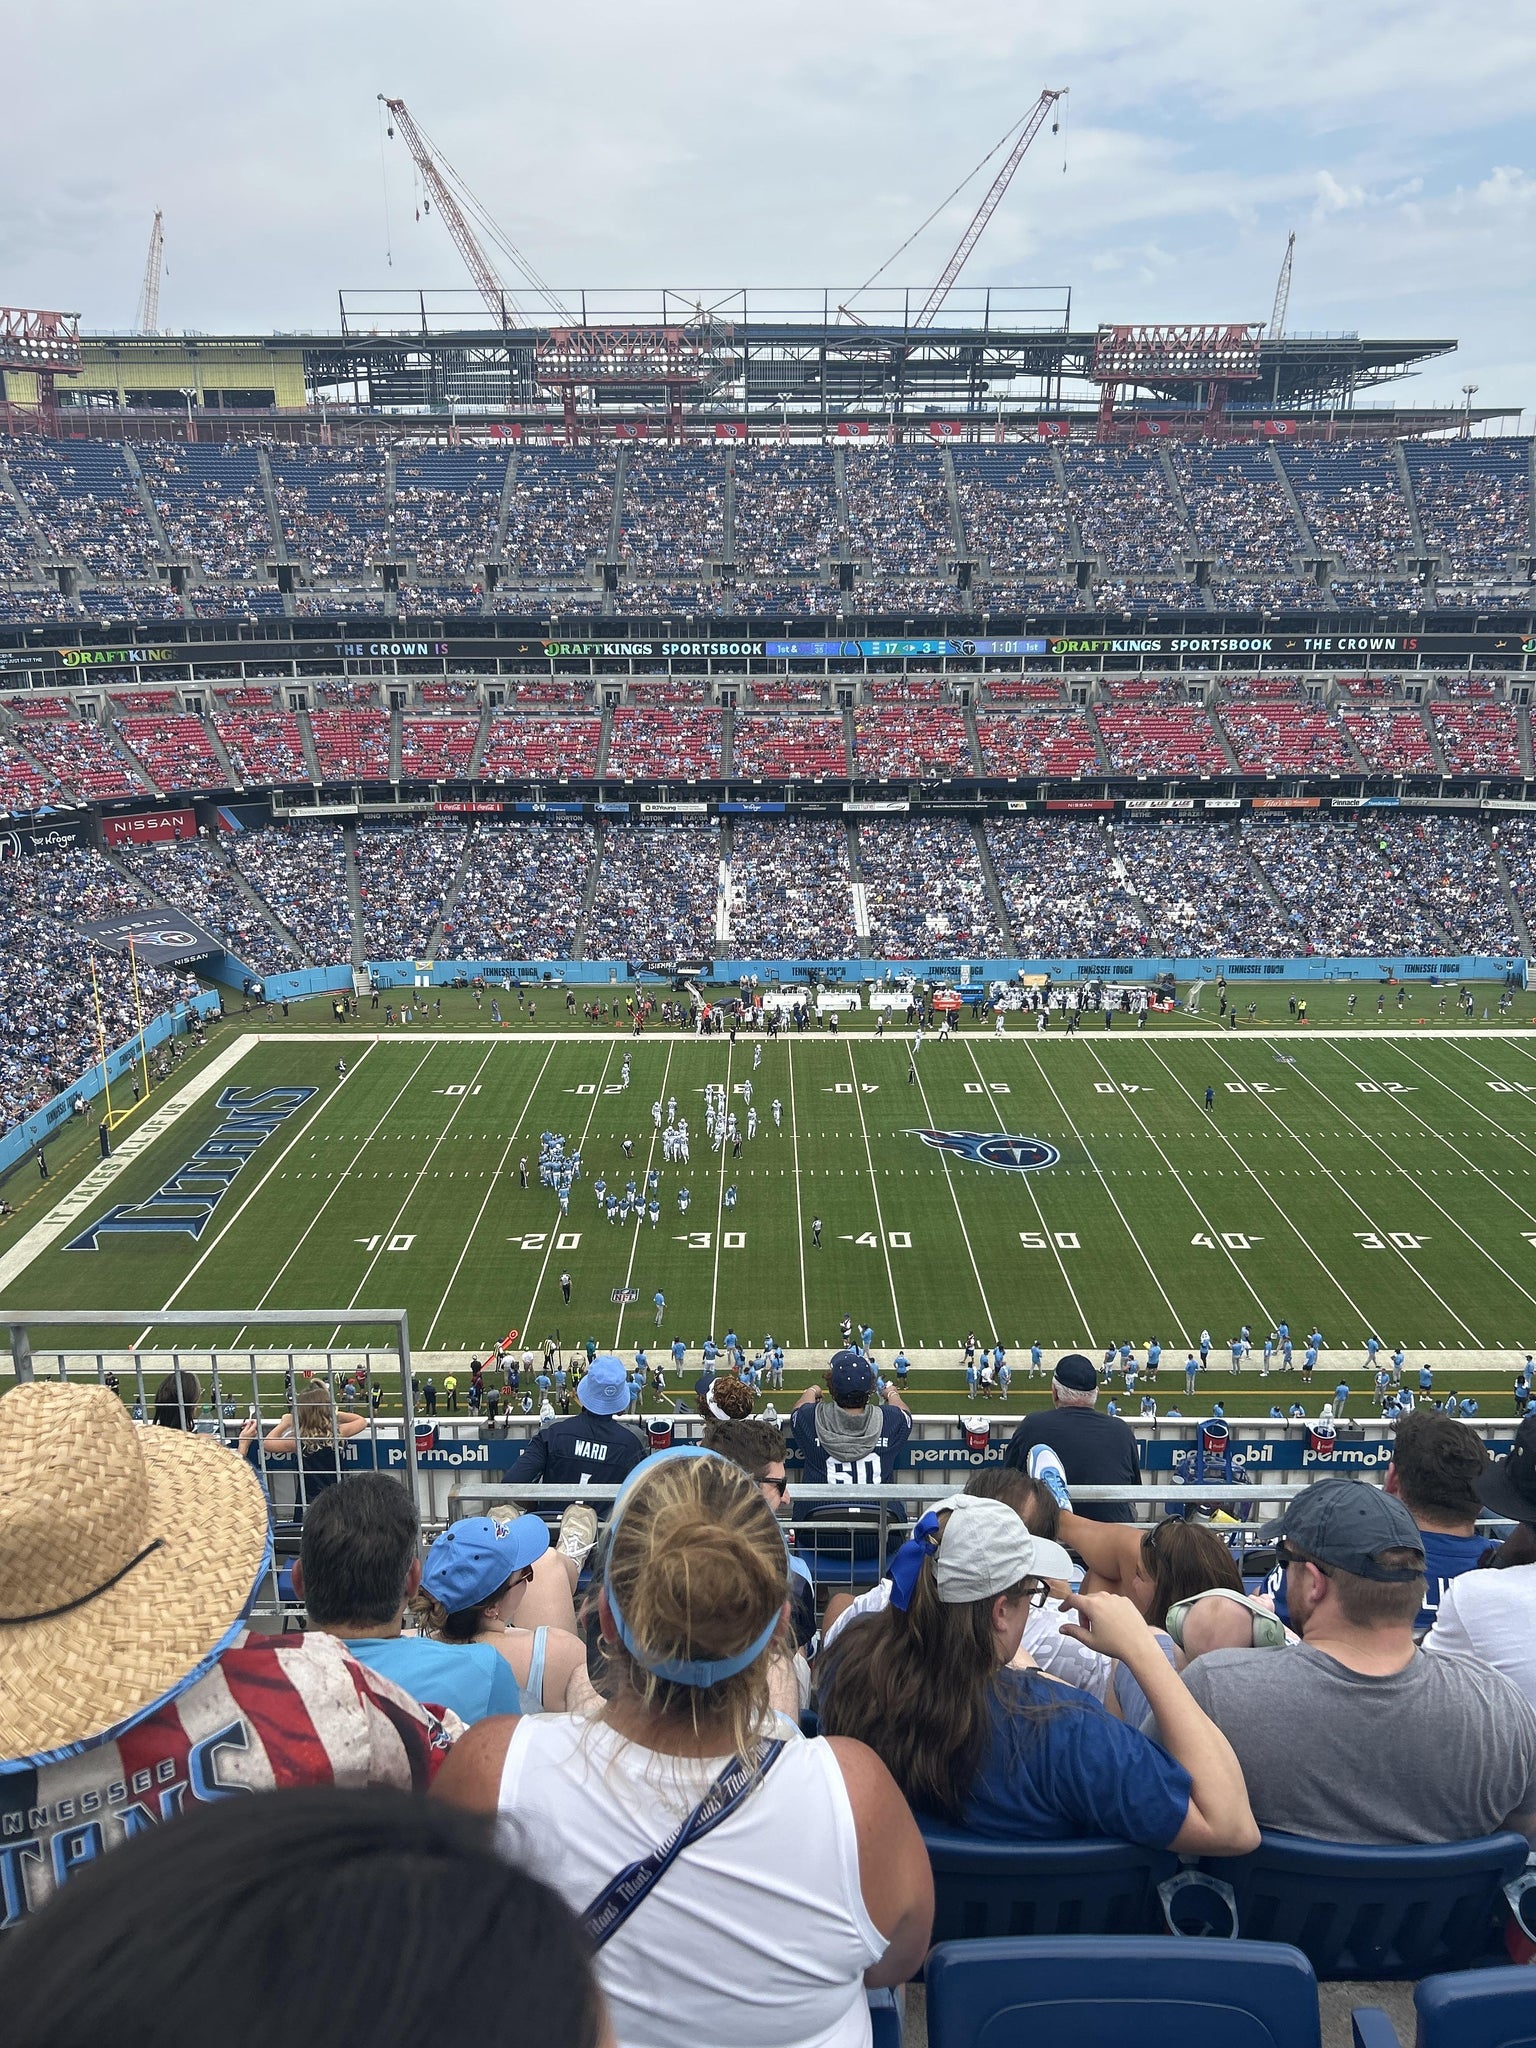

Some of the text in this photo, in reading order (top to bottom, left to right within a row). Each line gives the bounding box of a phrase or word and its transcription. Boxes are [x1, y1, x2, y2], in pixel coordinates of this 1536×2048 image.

[335, 643, 449, 656] THE CROWN IS
[544, 641, 762, 657] DRAFTKINGS SPORTSBOOK
[885, 643, 898, 654] 17
[922, 642, 931, 653] 3
[991, 640, 1018, 653] 1:01
[1026, 643, 1039, 652] 1st
[1052, 638, 1272, 654] DRAFTKINGS SPORTSBOOK
[1304, 638, 1417, 650] THE CROWN IS
[114, 816, 184, 832] NISSAN
[44, 831, 77, 848] Kroger
[98, 919, 170, 936] NISSAN
[174, 952, 209, 966] NISSAN
[482, 967, 538, 977] TENNESSEE TOUGH
[1077, 965, 1133, 975] TENNESSEE TOUGH
[1228, 964, 1285, 974] TENNESSEE TOUGH
[1404, 963, 1460, 974] TENNESSEE TOUGH
[43, 1102, 188, 1225] IT TAKES ALL OF US
[60, 1086, 320, 1251] TITANS
[366, 1234, 418, 1251] 10
[519, 1233, 582, 1250] 20
[687, 1232, 748, 1249] 30
[855, 1231, 912, 1248] 40
[1018, 1231, 1082, 1249] 50
[1190, 1232, 1252, 1249] 40
[1352, 1232, 1423, 1249] 30
[613, 1294, 636, 1302] NFL
[502, 1386, 512, 1395] 20
[388, 1444, 489, 1466] prmobil
[574, 1439, 608, 1461] WARD
[910, 1443, 1009, 1466] permobi
[1302, 1444, 1395, 1466] permob
[826, 1452, 882, 1485] 60
[615, 1866, 653, 1903] Titans
